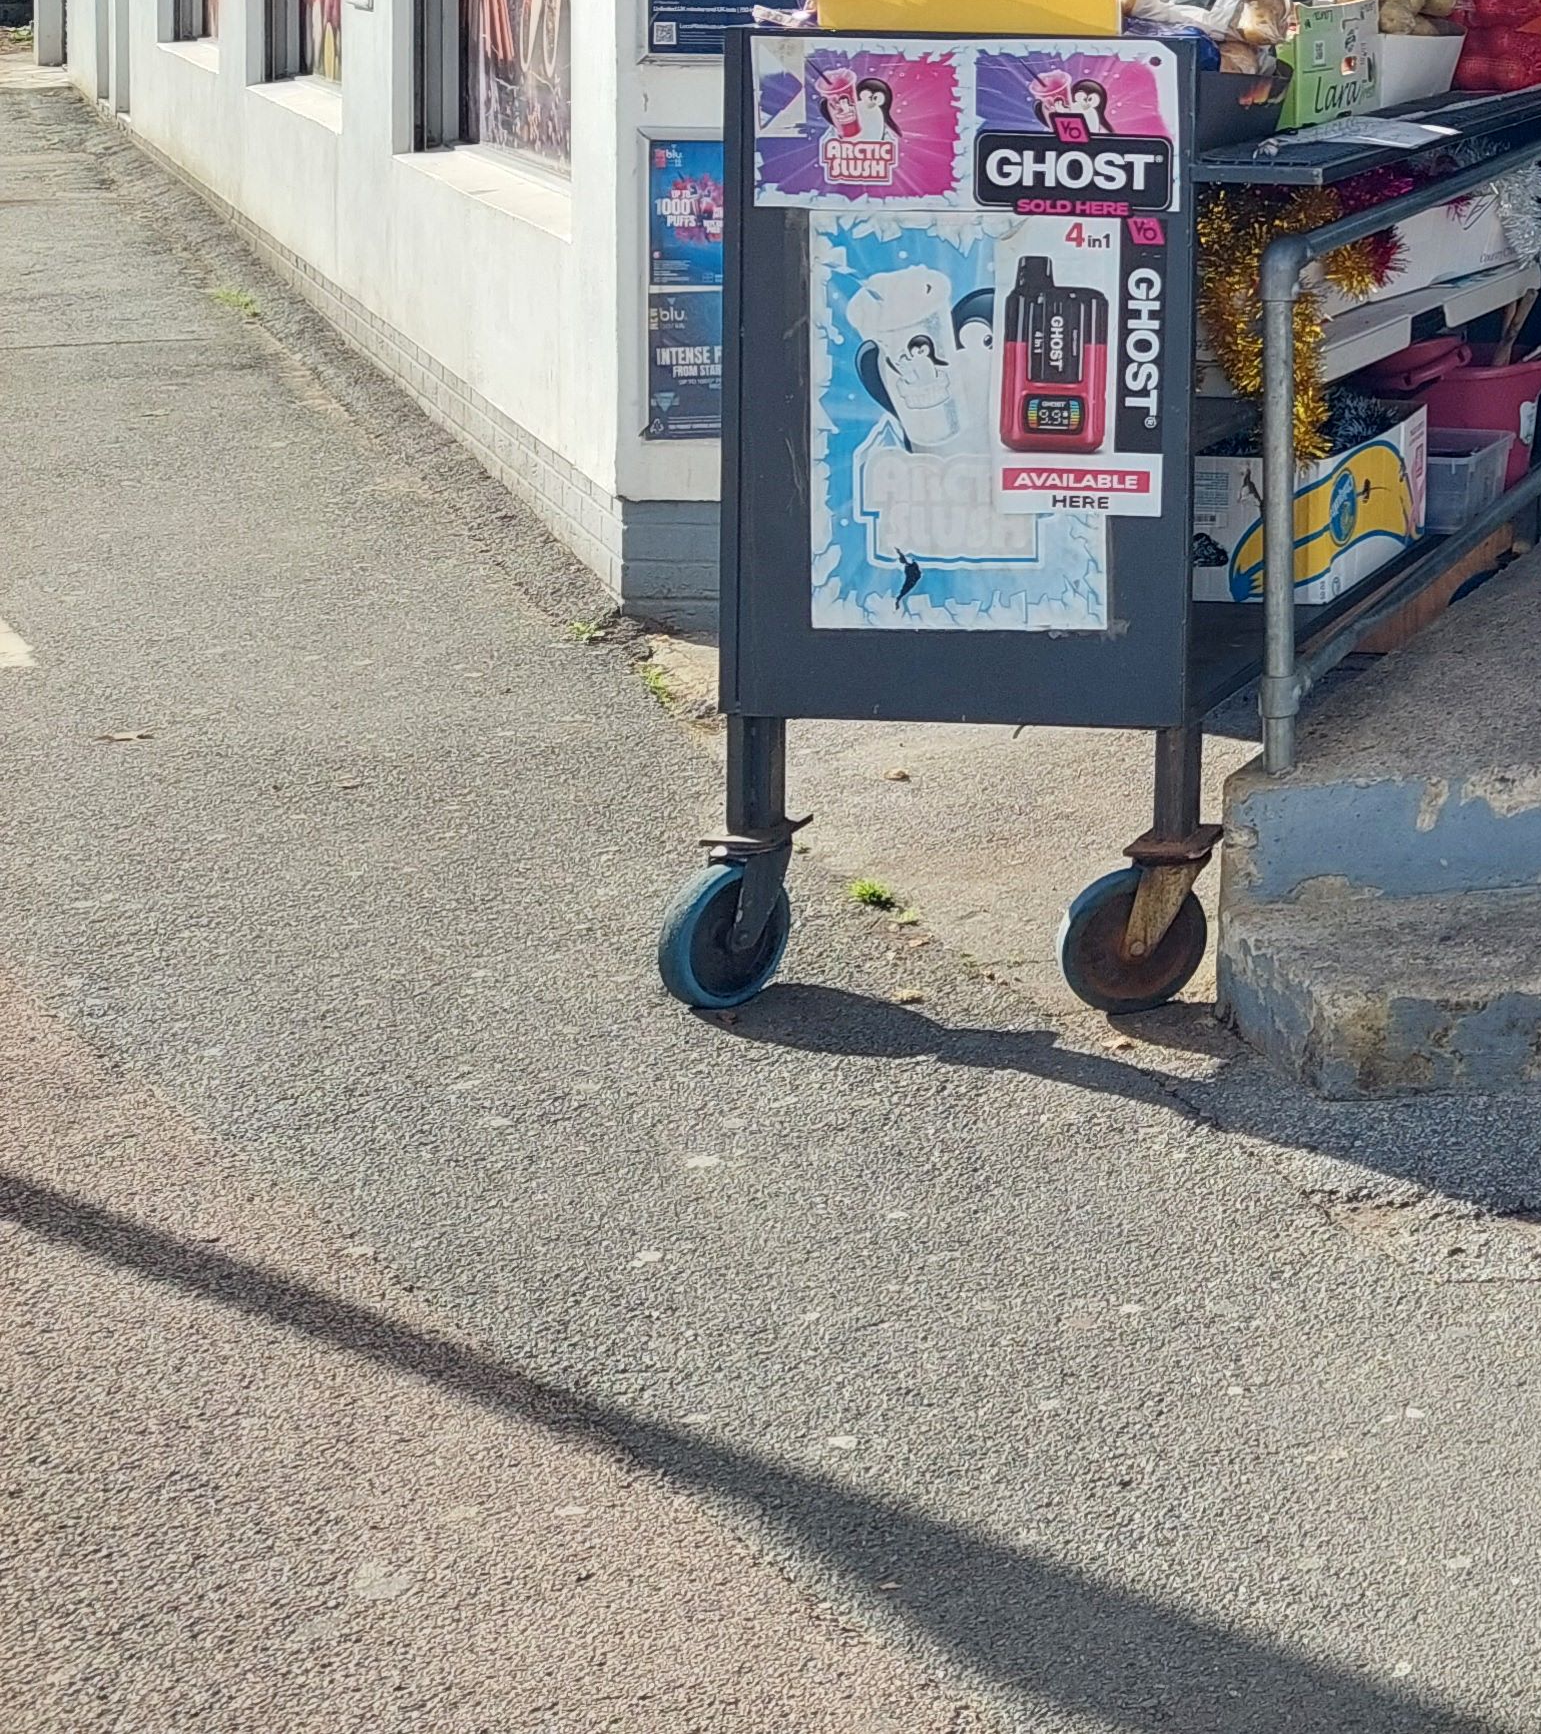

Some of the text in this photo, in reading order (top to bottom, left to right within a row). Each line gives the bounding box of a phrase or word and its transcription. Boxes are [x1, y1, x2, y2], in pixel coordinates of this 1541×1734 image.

[1313, 77, 1360, 114] Lara
[666, 148, 683, 159] blu
[826, 142, 893, 160] ARCTIC
[830, 159, 887, 177] SLUSH
[1016, 200, 1130, 215] SOLD HERE
[658, 308, 686, 322] blu
[1050, 316, 1063, 369] GHOST
[672, 365, 697, 378] FROM
[1014, 472, 1138, 490] AVAILABLE
[1051, 494, 1110, 510] HERE
